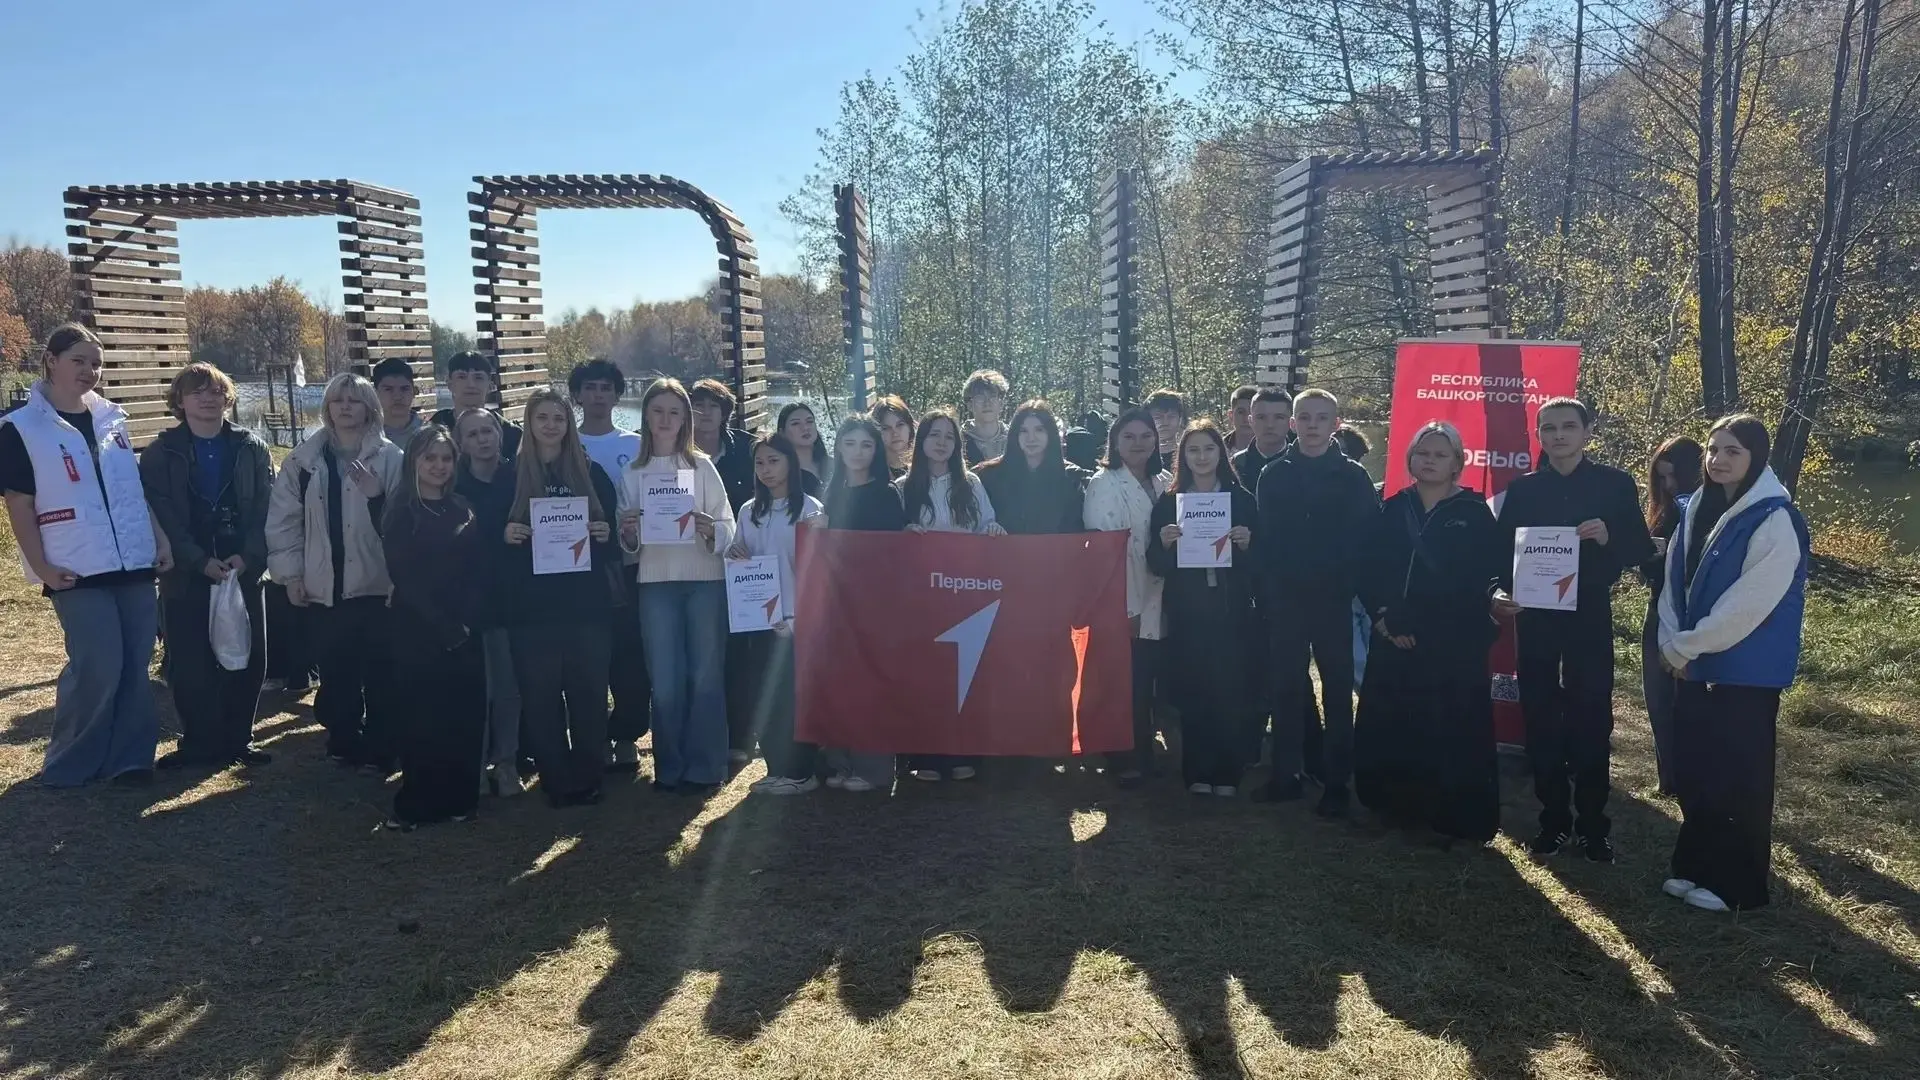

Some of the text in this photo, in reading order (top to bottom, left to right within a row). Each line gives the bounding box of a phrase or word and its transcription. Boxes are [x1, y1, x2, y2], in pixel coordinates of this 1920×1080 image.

[1431, 374, 1538, 389] РЕСПУБЛИКА
[1416, 389, 1550, 405] БАШКОРТОСТАН
[648, 488, 688, 496] ДИПЛОМ
[540, 514, 583, 524] ДИПЛОМ
[1185, 511, 1225, 519] ДИПЛОМ
[1524, 546, 1572, 555] ДИПЛОМ
[734, 573, 773, 584] ДИПЛОМ
[930, 572, 1003, 594] Первые
